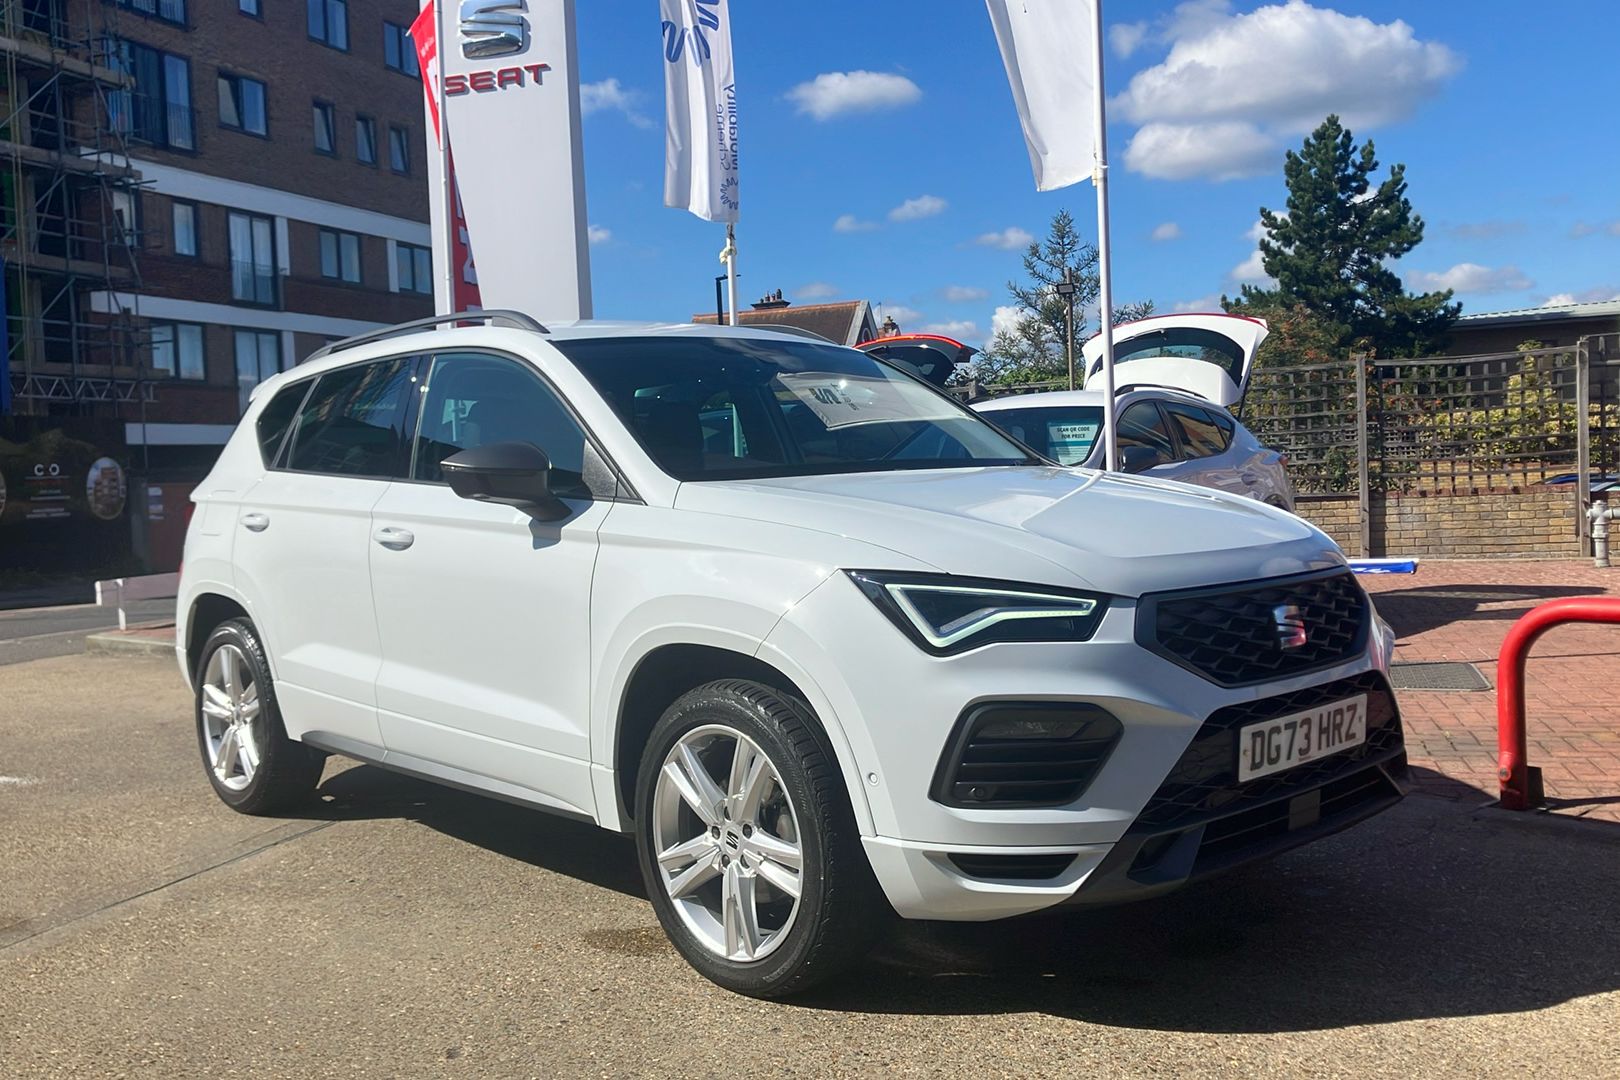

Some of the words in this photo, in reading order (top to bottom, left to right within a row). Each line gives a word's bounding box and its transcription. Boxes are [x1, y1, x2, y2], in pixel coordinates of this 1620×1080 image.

[445, 63, 550, 96] SEAT
[1250, 717, 1313, 772] DG73
[1317, 703, 1358, 750] HRZ
